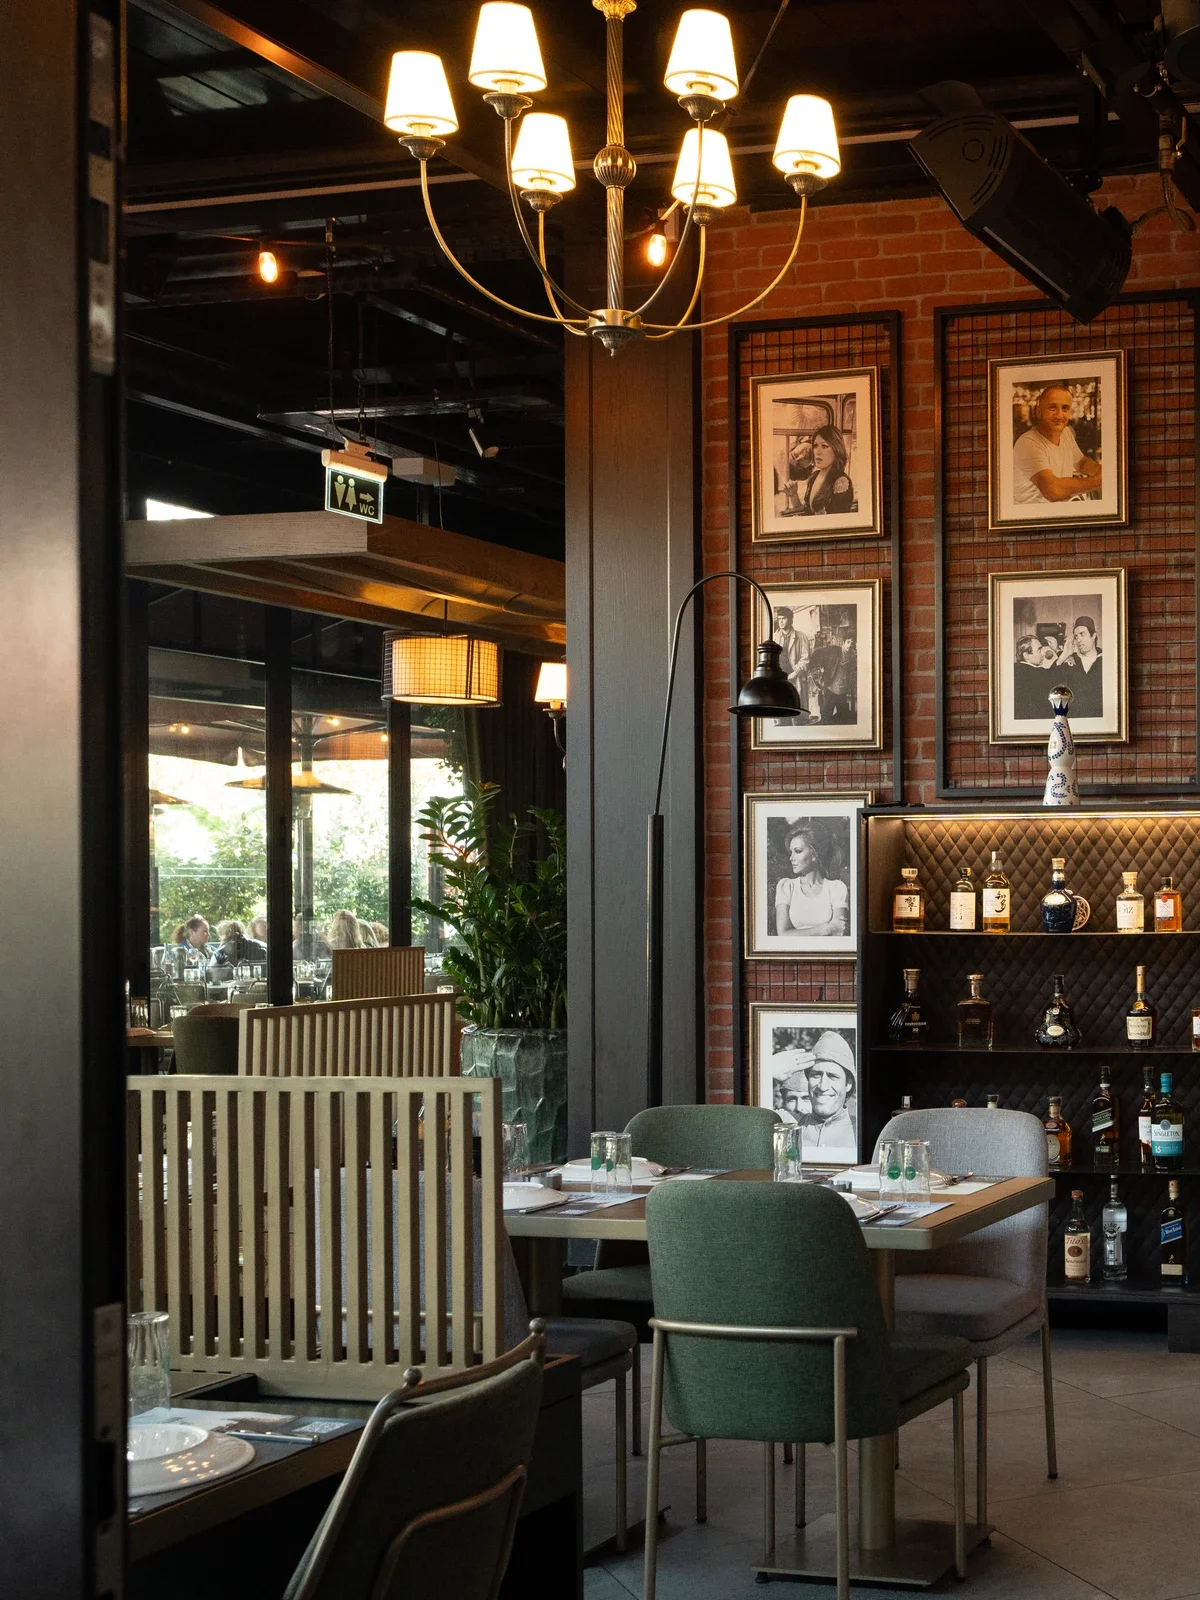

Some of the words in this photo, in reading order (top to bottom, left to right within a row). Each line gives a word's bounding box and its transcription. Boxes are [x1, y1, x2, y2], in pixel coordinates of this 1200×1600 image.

[359, 502, 375, 516] WC
[1155, 1145, 1161, 1154] 15
[1066, 1236, 1085, 1245] Tito's
